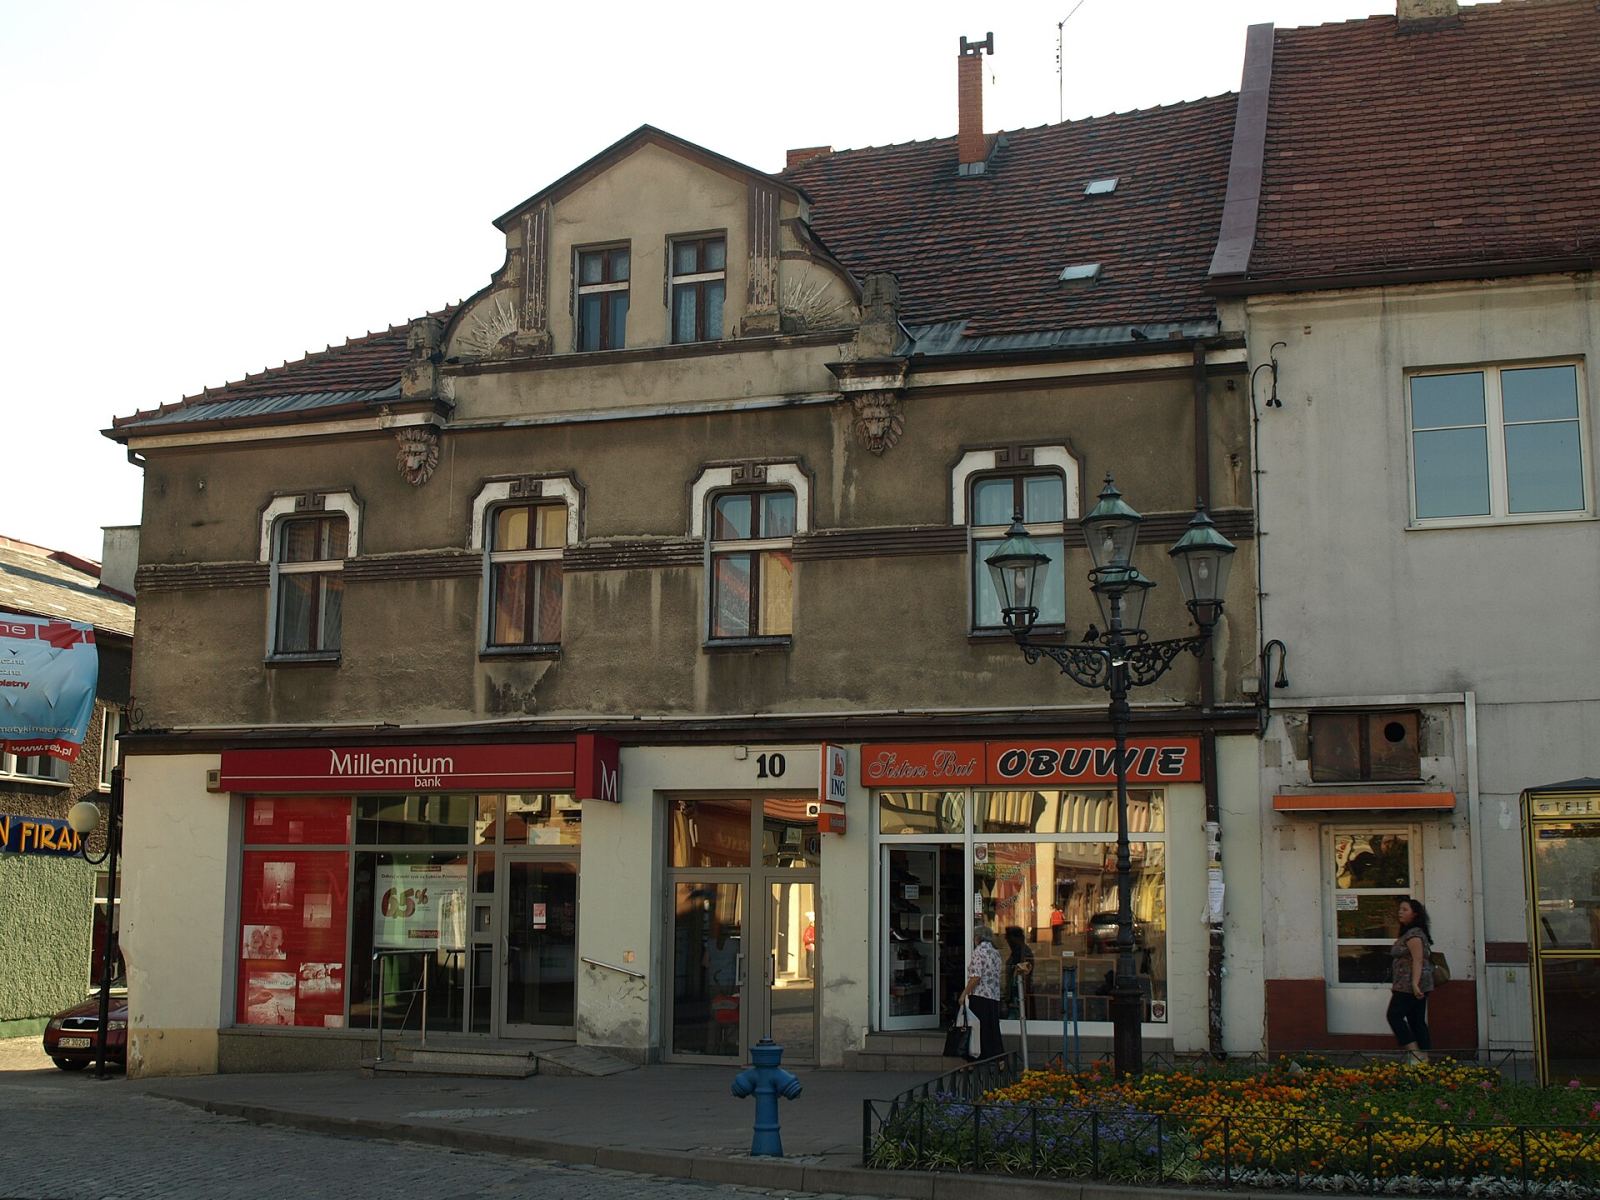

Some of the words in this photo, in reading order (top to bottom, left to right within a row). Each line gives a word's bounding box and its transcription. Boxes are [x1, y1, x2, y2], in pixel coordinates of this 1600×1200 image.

[328, 749, 454, 775] Millennium
[756, 753, 786, 778] 10
[996, 746, 1187, 777] OBUWIE
[414, 775, 441, 788] bank
[600, 759, 617, 803] M
[831, 778, 845, 797] ING
